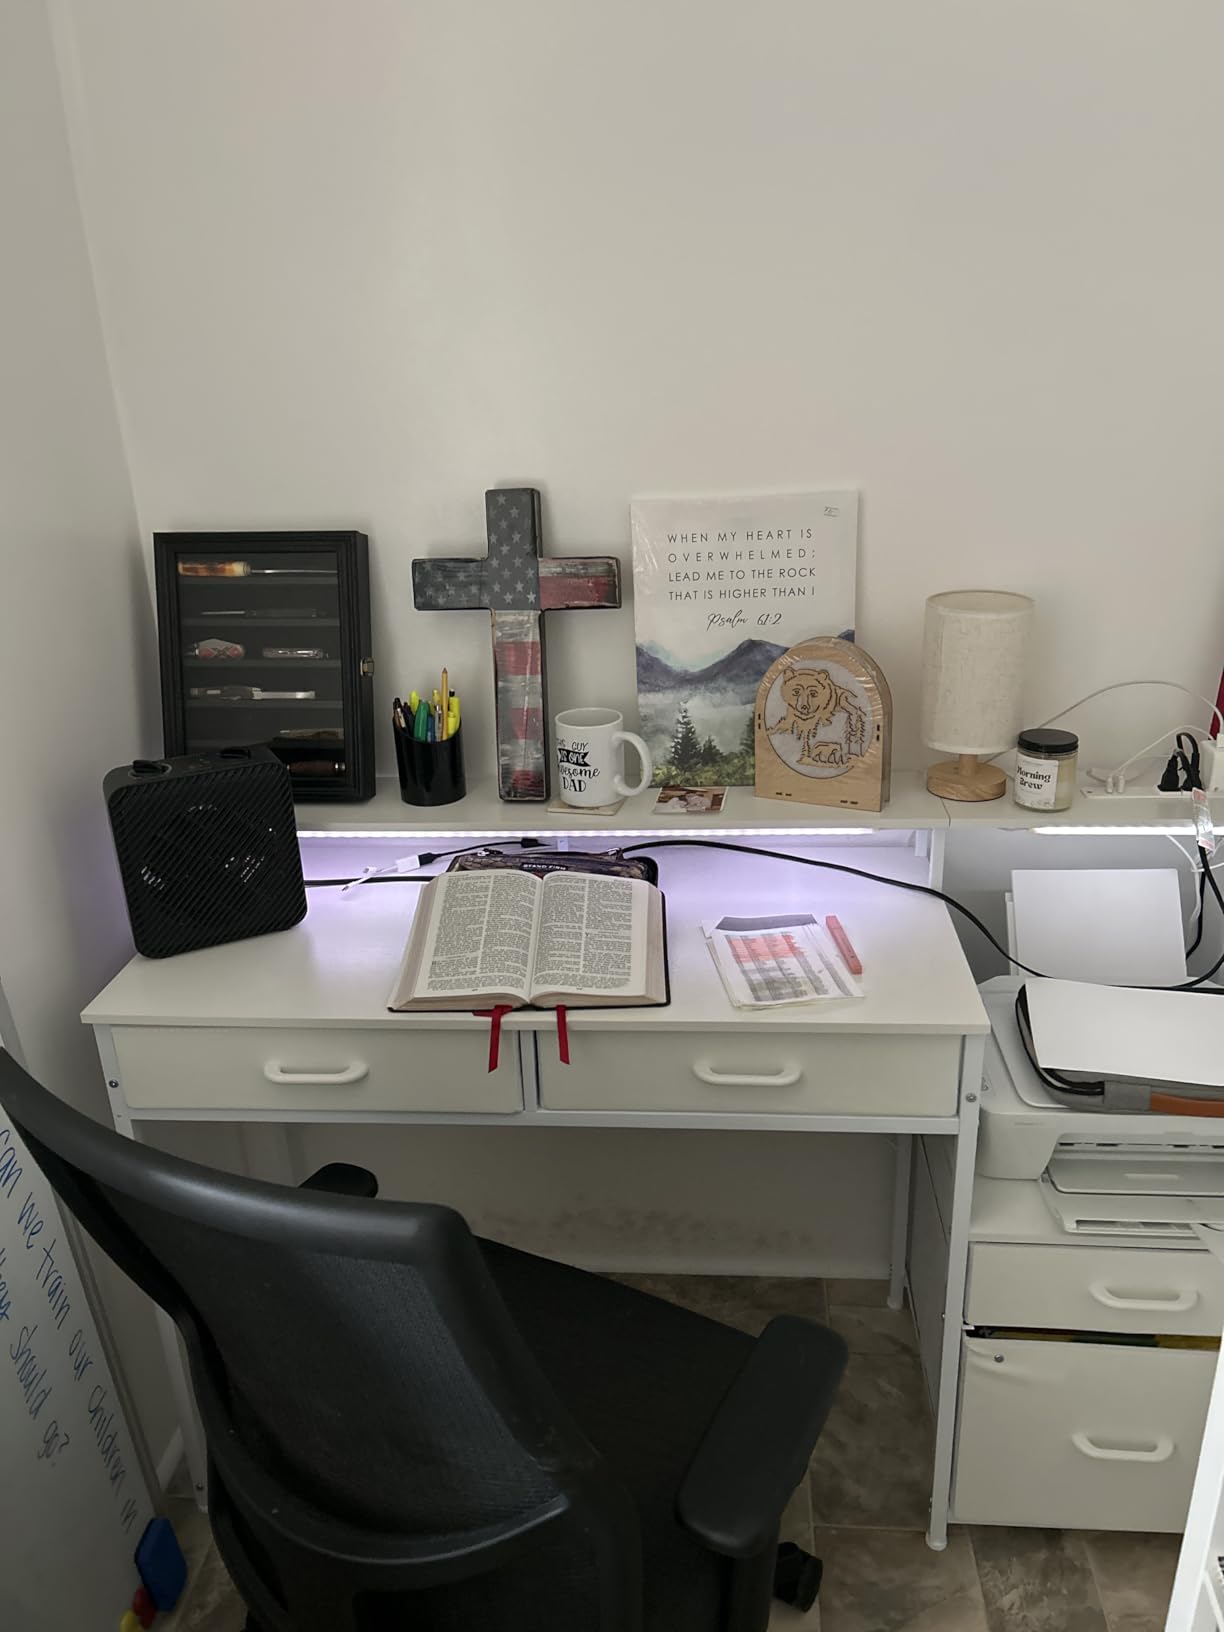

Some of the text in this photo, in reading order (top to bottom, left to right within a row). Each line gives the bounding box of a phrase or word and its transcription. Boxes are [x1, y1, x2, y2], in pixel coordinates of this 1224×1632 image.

[667, 529, 812, 543] WHEN MY HEART IS
[668, 548, 816, 563] OVERWHELMED;
[668, 567, 816, 582] LEAD ME TO THE ROCK
[668, 586, 815, 600] THAT IS HIGHER THAN I
[706, 609, 782, 632] Psalm 61:2
[572, 741, 588, 751] GUY
[569, 752, 585, 764] ONE
[562, 776, 587, 792] DAD
[36, 1238, 71, 1331] train
[69, 1329, 94, 1382] our
[120, 1499, 138, 1535] in
